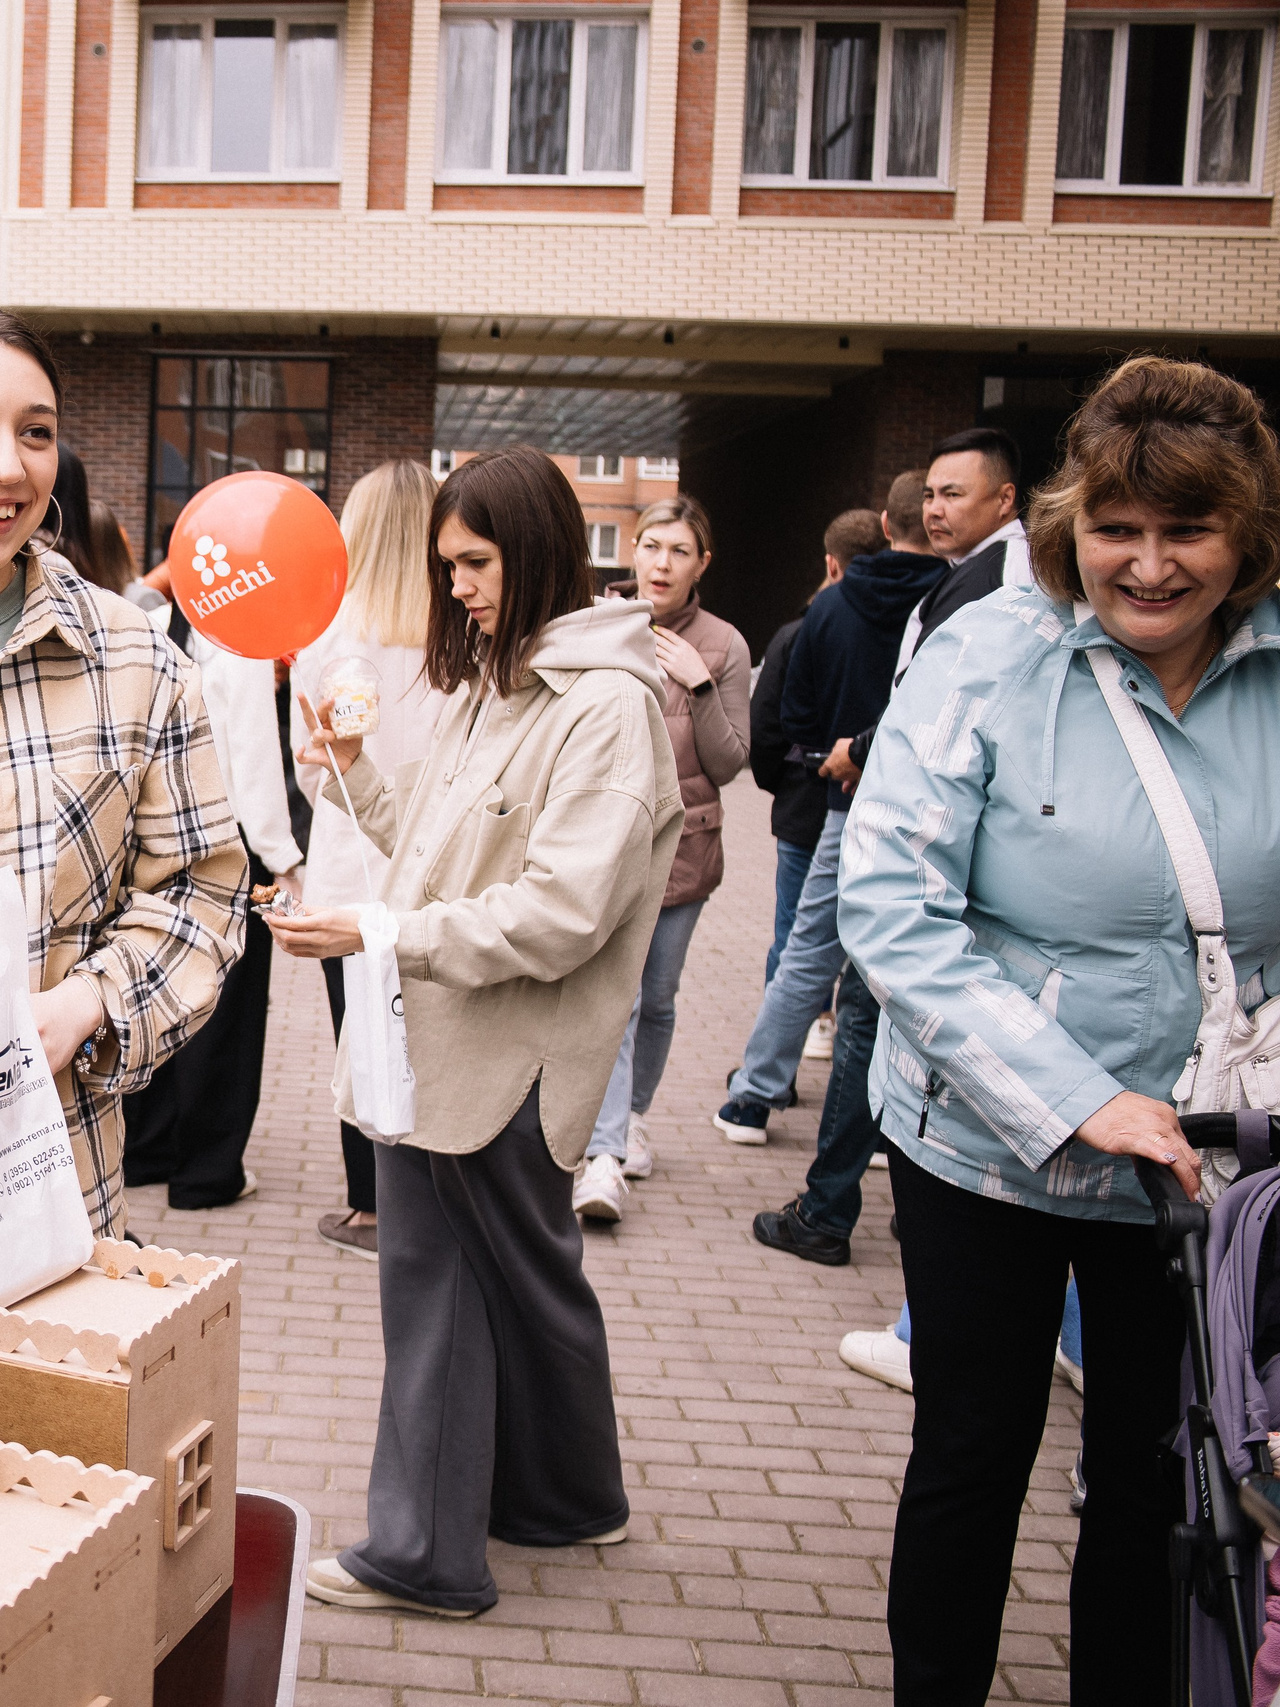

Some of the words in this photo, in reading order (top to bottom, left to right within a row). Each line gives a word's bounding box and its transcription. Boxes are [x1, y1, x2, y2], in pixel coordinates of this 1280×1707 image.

[189, 560, 276, 620] kimchi
[3, 1172, 8, 1183] 8
[8, 1160, 33, 1182] (3952)
[6, 1185, 12, 1196] 8
[12, 1175, 35, 1195] (902)
